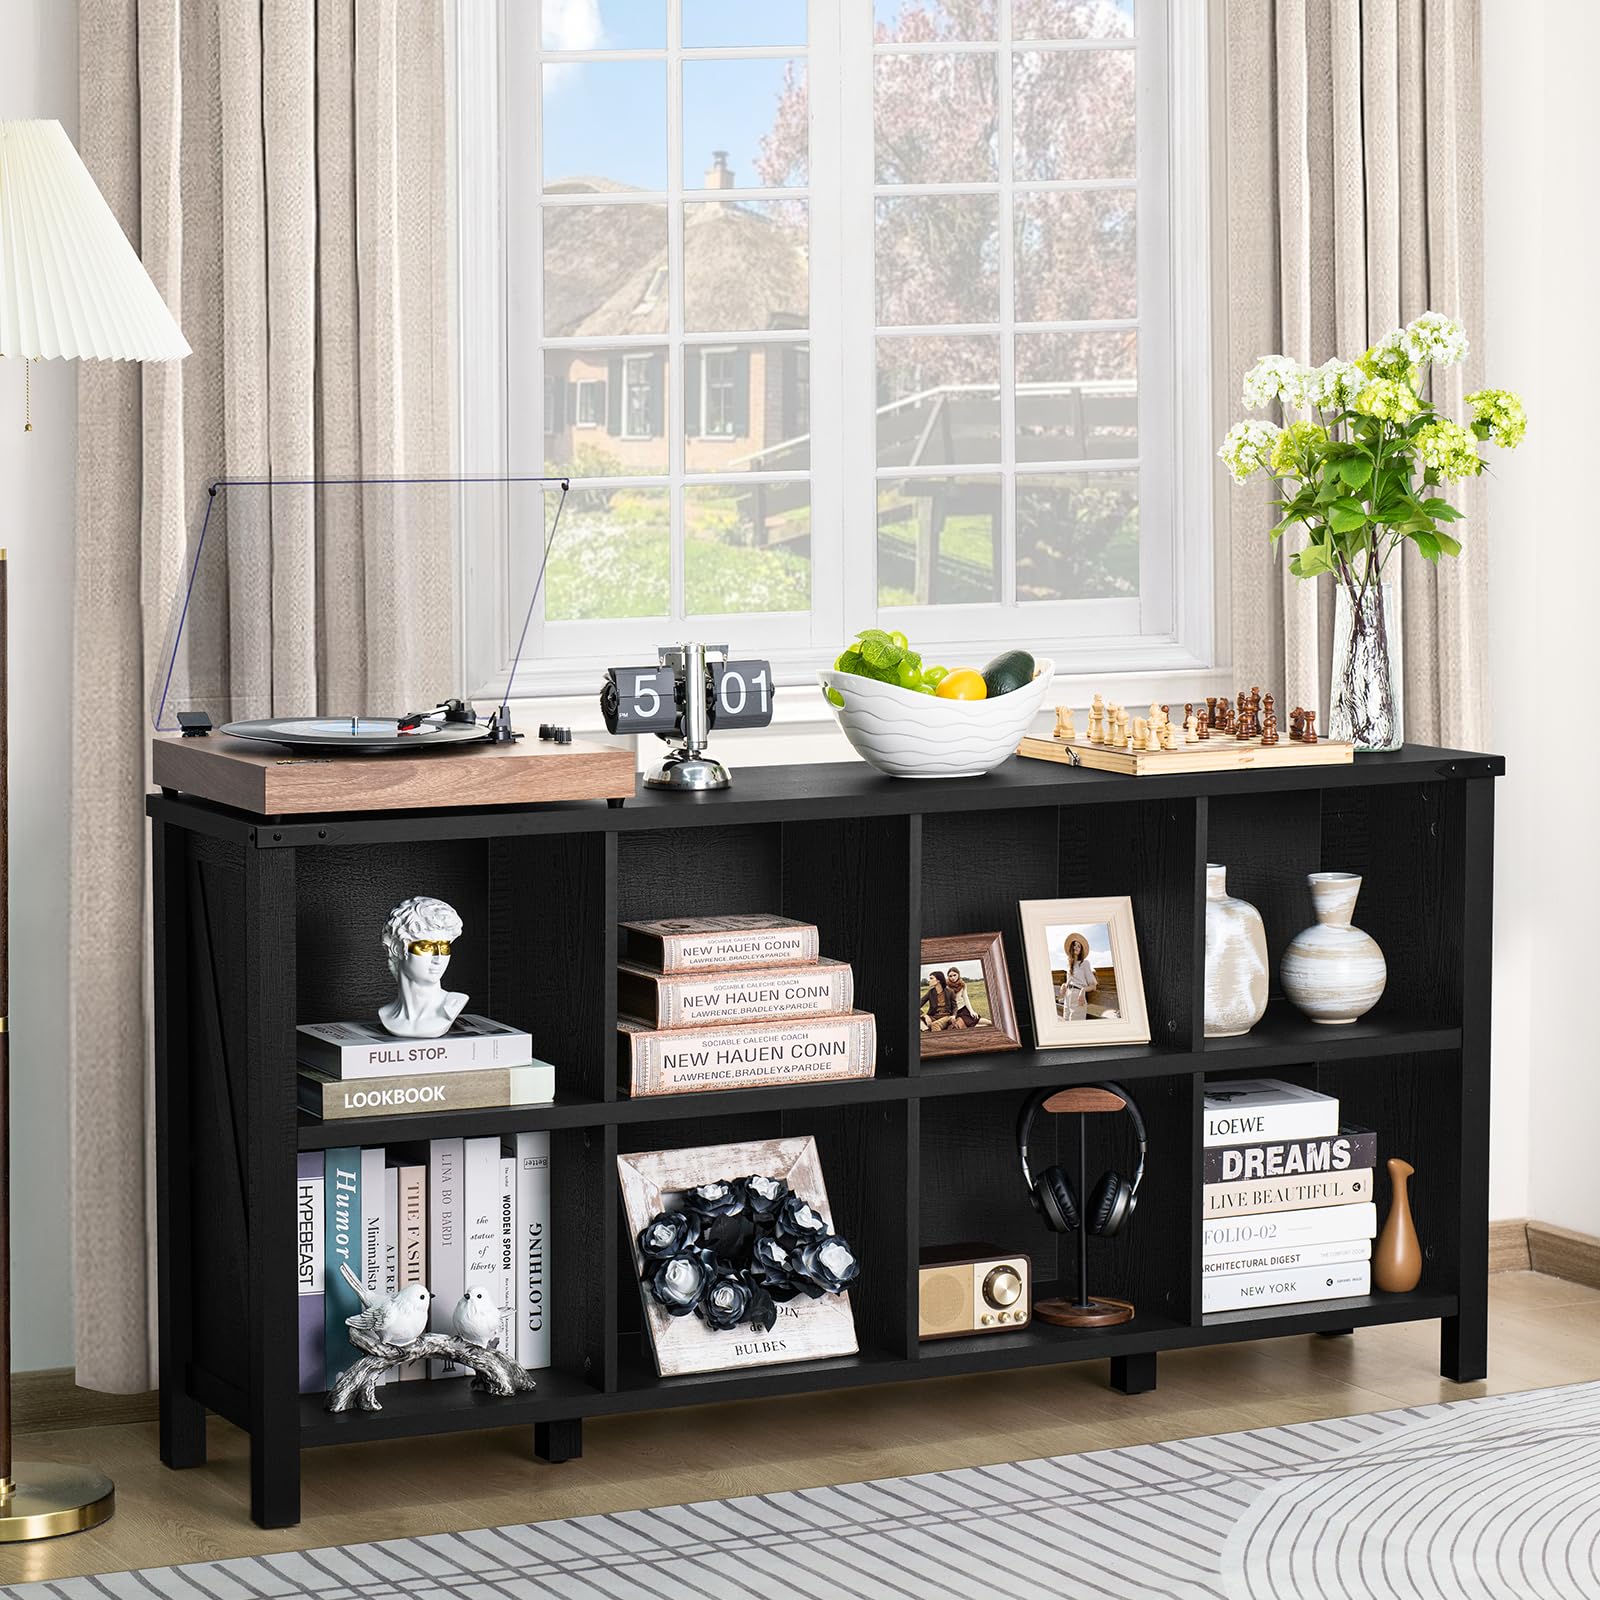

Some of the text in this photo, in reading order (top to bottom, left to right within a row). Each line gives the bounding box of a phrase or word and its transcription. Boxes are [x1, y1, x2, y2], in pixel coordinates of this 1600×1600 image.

[633, 670, 768, 718] 5 01
[683, 940, 801, 957] NEW HAUEN CONN
[746, 981, 775, 989] CALECHE
[776, 979, 800, 987] COACH
[683, 985, 830, 1008] NEW HAUEN CONN
[702, 1033, 809, 1048] SOCIABLE CALECHE COACH
[369, 1047, 448, 1064] FULL STOP.
[663, 1040, 847, 1069] NEW HAUEN CONN
[344, 1086, 447, 1109] LOOKBOOK
[1210, 1116, 1265, 1136] LOEWE
[525, 1159, 548, 1167] Better
[1222, 1138, 1352, 1180] DREAMS
[408, 1181, 420, 1221] THE
[442, 1153, 453, 1247] LINA BO BARDI
[1210, 1192, 1249, 1210] LIVE
[1253, 1182, 1344, 1206] BEAUTIFUL
[336, 1168, 357, 1260] Humor
[476, 1216, 489, 1225] the
[299, 1185, 314, 1287] HYPEBEAST
[470, 1232, 495, 1240] statue
[502, 1194, 511, 1270] WOODEN SPOON
[1204, 1223, 1278, 1245] FOLIO-02
[367, 1216, 380, 1291] Minimalista
[478, 1245, 490, 1258] of
[1270, 1254, 1301, 1266] DIGEST
[470, 1261, 497, 1273] liberty
[529, 1222, 543, 1331] CLOTHING
[1240, 1282, 1298, 1297] NEW YORK
[775, 1305, 800, 1318] DIN
[750, 1321, 763, 1332] de
[734, 1340, 787, 1356] BULBES
